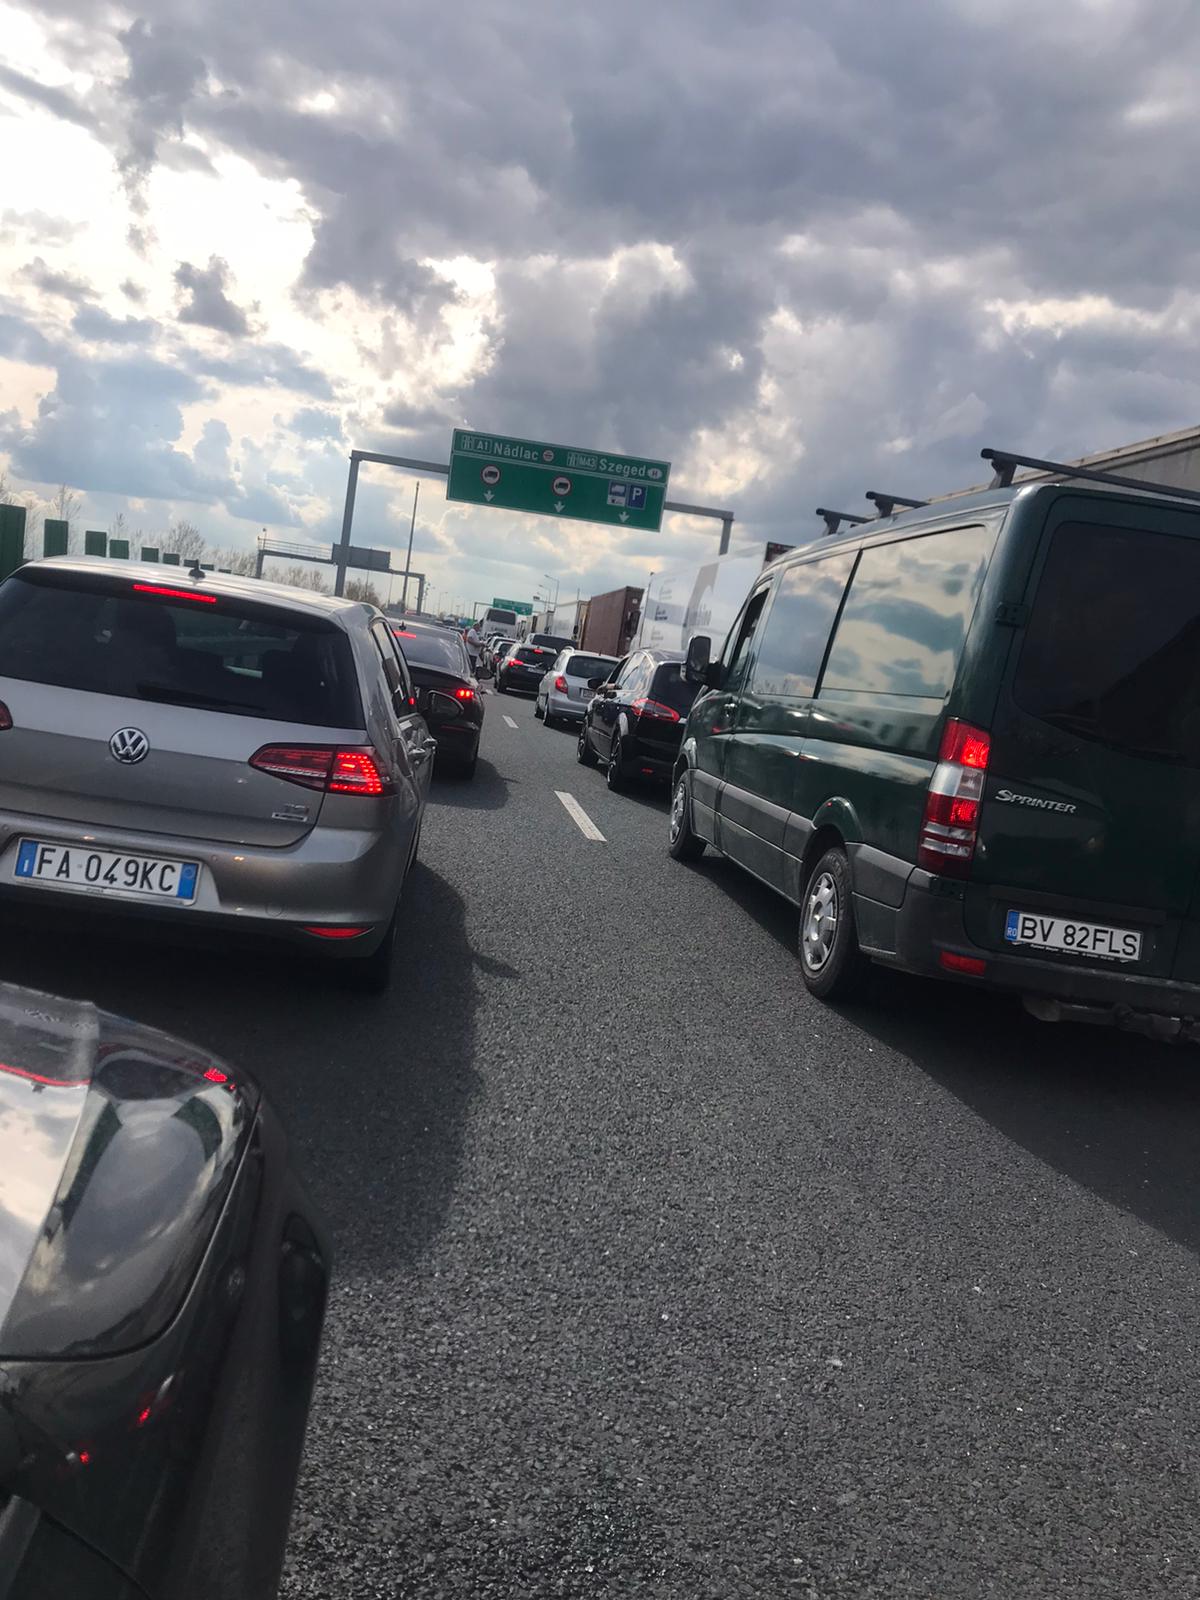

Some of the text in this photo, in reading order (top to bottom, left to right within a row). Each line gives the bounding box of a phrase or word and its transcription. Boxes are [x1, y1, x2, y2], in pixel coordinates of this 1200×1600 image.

[477, 440, 488, 450] A1
[599, 458, 646, 476] Szeged
[632, 487, 642, 501] P
[36, 847, 176, 892] FA 049KC
[1007, 928, 1017, 937] RO
[1020, 917, 1055, 942] BV
[1063, 924, 1138, 956] 82FLS
